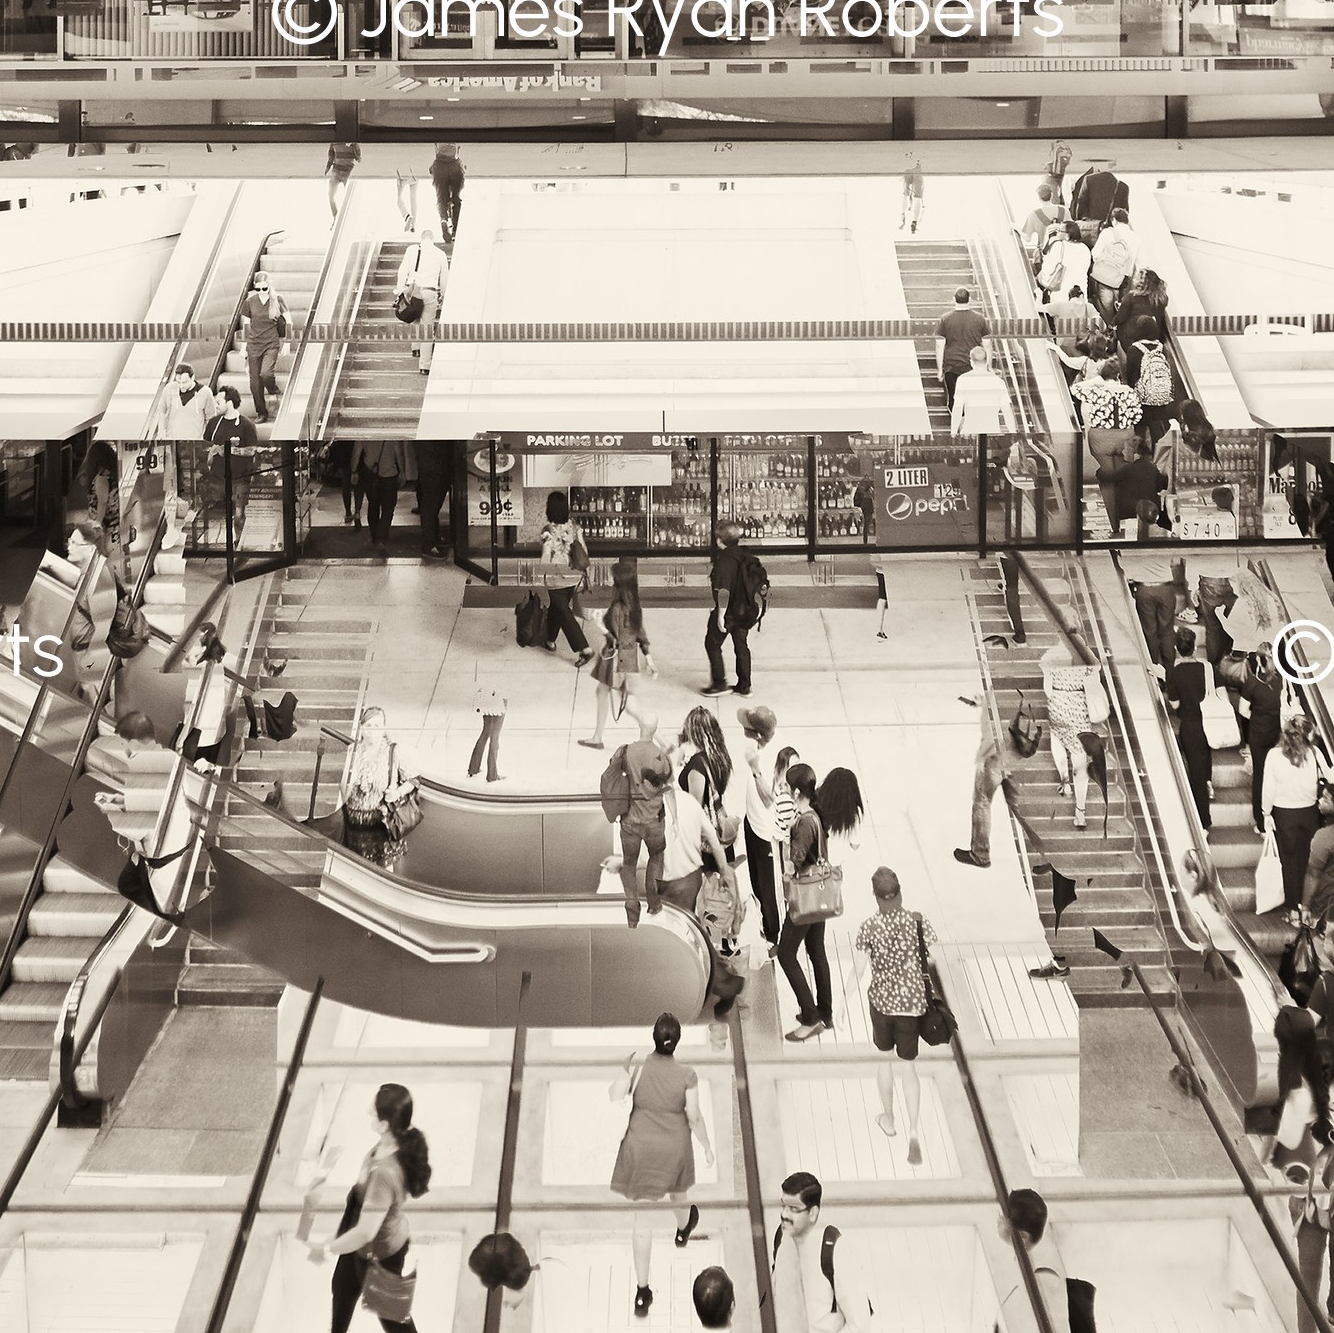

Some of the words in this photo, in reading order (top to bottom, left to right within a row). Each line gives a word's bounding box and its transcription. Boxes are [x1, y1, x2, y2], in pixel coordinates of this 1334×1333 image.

[526, 435, 592, 447] PARKING
[594, 435, 624, 447] LOT
[886, 471, 894, 487] 2
[898, 469, 927, 486] LITER
